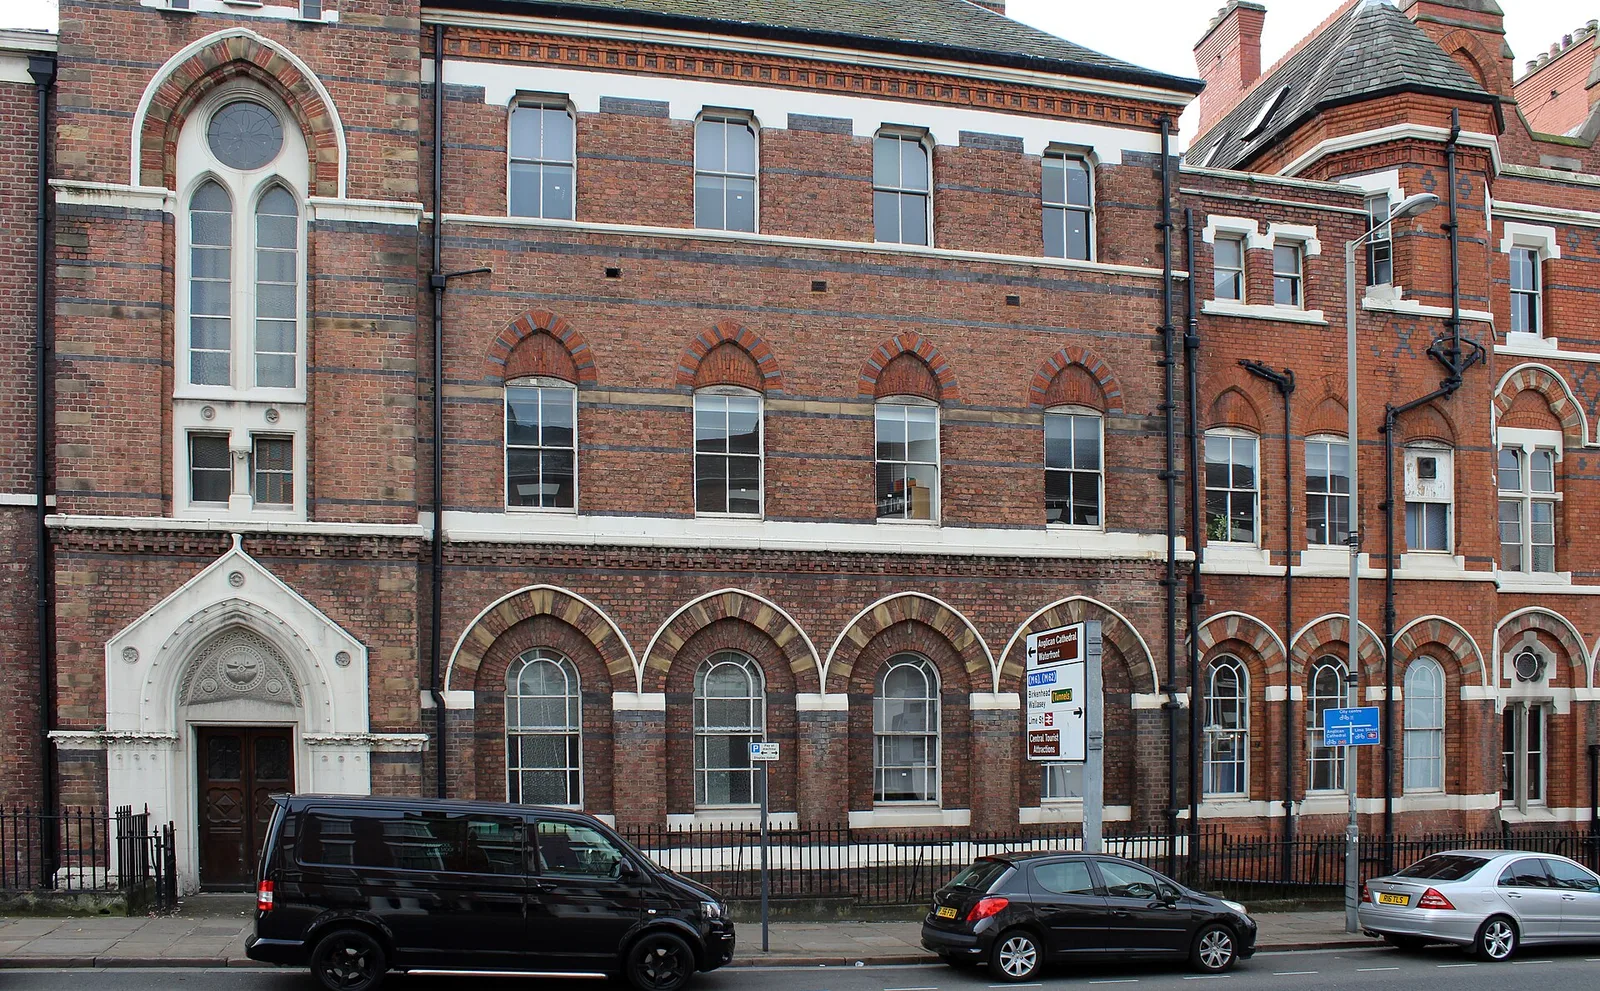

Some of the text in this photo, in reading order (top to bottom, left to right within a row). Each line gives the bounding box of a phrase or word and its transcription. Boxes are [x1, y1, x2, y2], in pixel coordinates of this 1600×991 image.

[1038, 631, 1077, 648] Anglican Cathedral
[1038, 649, 1060, 661] Waterfront
[1029, 688, 1050, 698] Birkenhead
[1029, 700, 1046, 709] Wallasey
[1029, 716, 1037, 724] Lime
[1030, 733, 1059, 743] Central Tourist
[1033, 744, 1056, 753] Attractions
